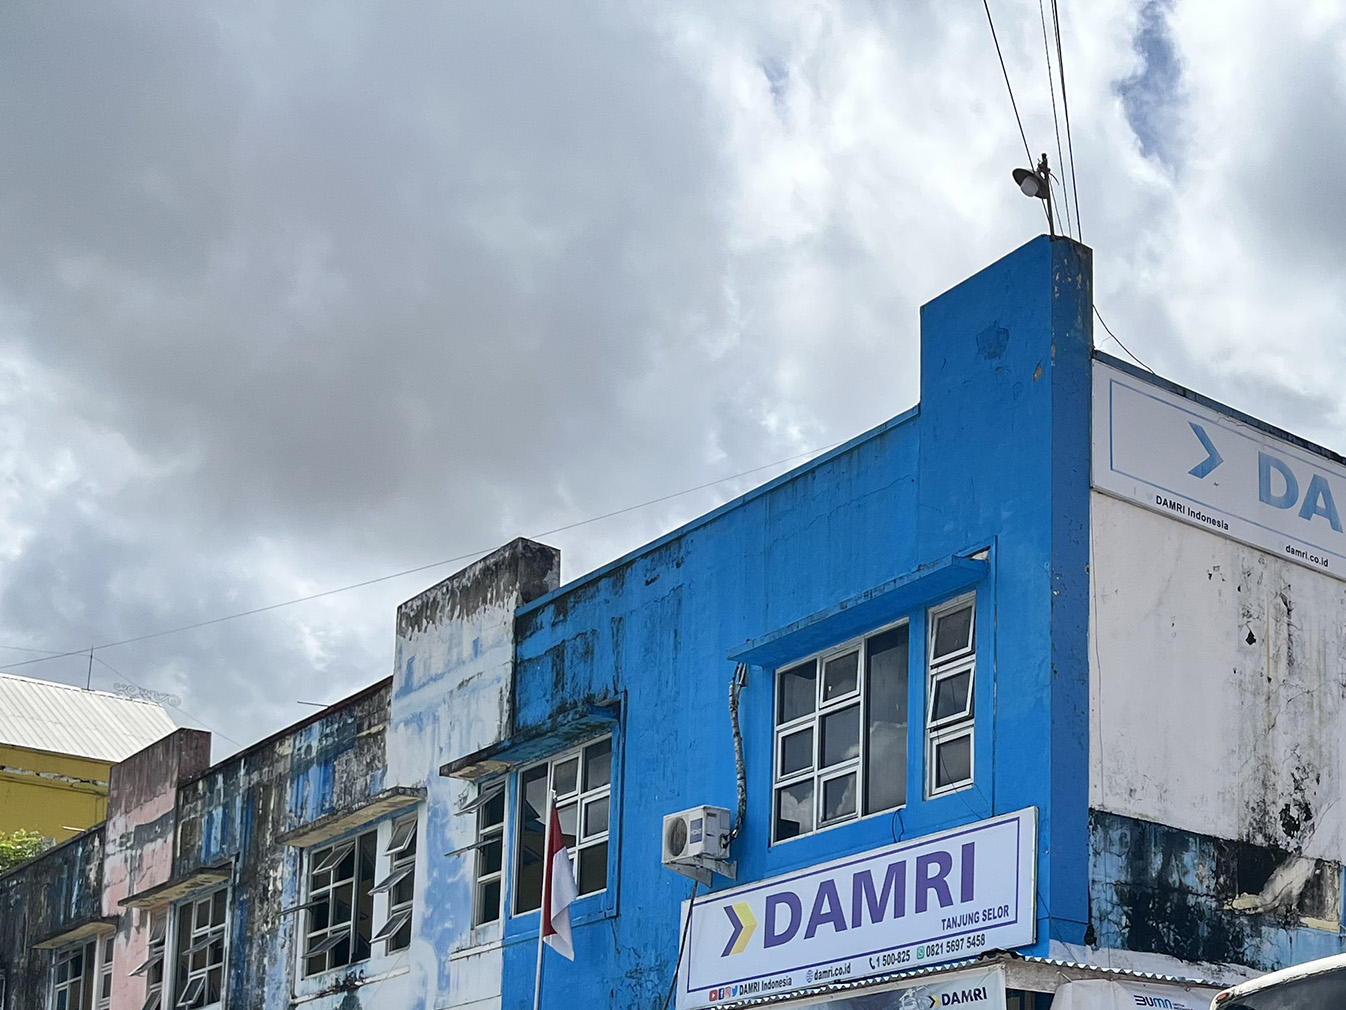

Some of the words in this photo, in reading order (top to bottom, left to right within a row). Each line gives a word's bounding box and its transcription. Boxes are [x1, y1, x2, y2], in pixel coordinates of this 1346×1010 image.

[1155, 494, 1186, 514] DAMRI
[1187, 506, 1229, 531] Indonesia
[1285, 544, 1329, 568] damri.co.id
[763, 841, 976, 950] DAMRI
[941, 912, 980, 931] TANJUNG
[981, 904, 1010, 922] SELOR
[925, 942, 944, 958] 0821
[946, 937, 965, 954] 5697
[966, 933, 986, 949] 5458
[882, 949, 911, 967] 500-825
[814, 962, 851, 981] damri.co.id
[739, 981, 760, 996] DAMRI
[761, 975, 793, 991] Indonesia
[941, 986, 988, 1008] DAMRI
